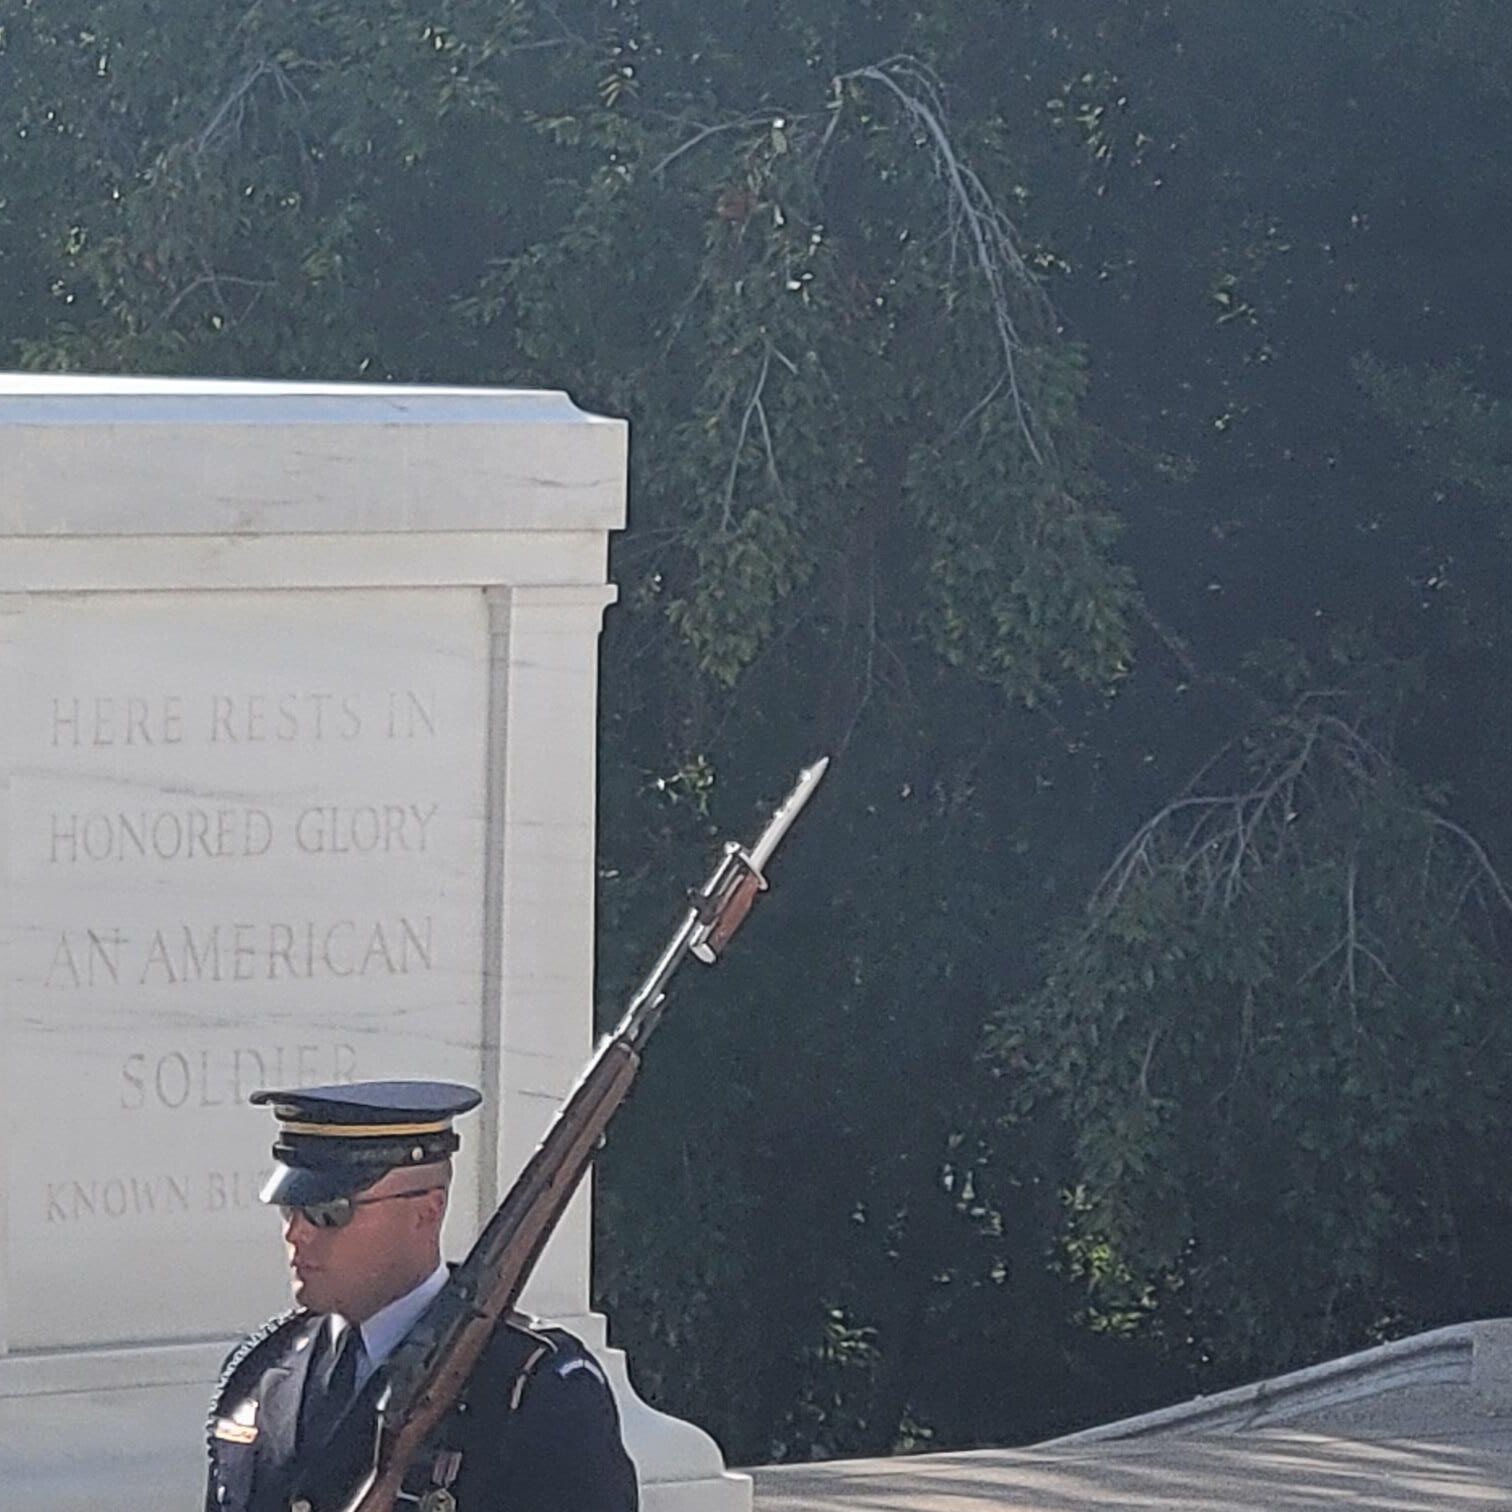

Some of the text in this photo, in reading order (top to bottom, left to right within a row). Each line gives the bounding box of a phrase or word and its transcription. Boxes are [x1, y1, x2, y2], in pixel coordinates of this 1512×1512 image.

[50, 689, 437, 748] HERE RESTS IN
[49, 802, 440, 864] HONORED GLORY
[44, 916, 434, 988] AN AMERICAN
[46, 1173, 192, 1223] KNOWN
